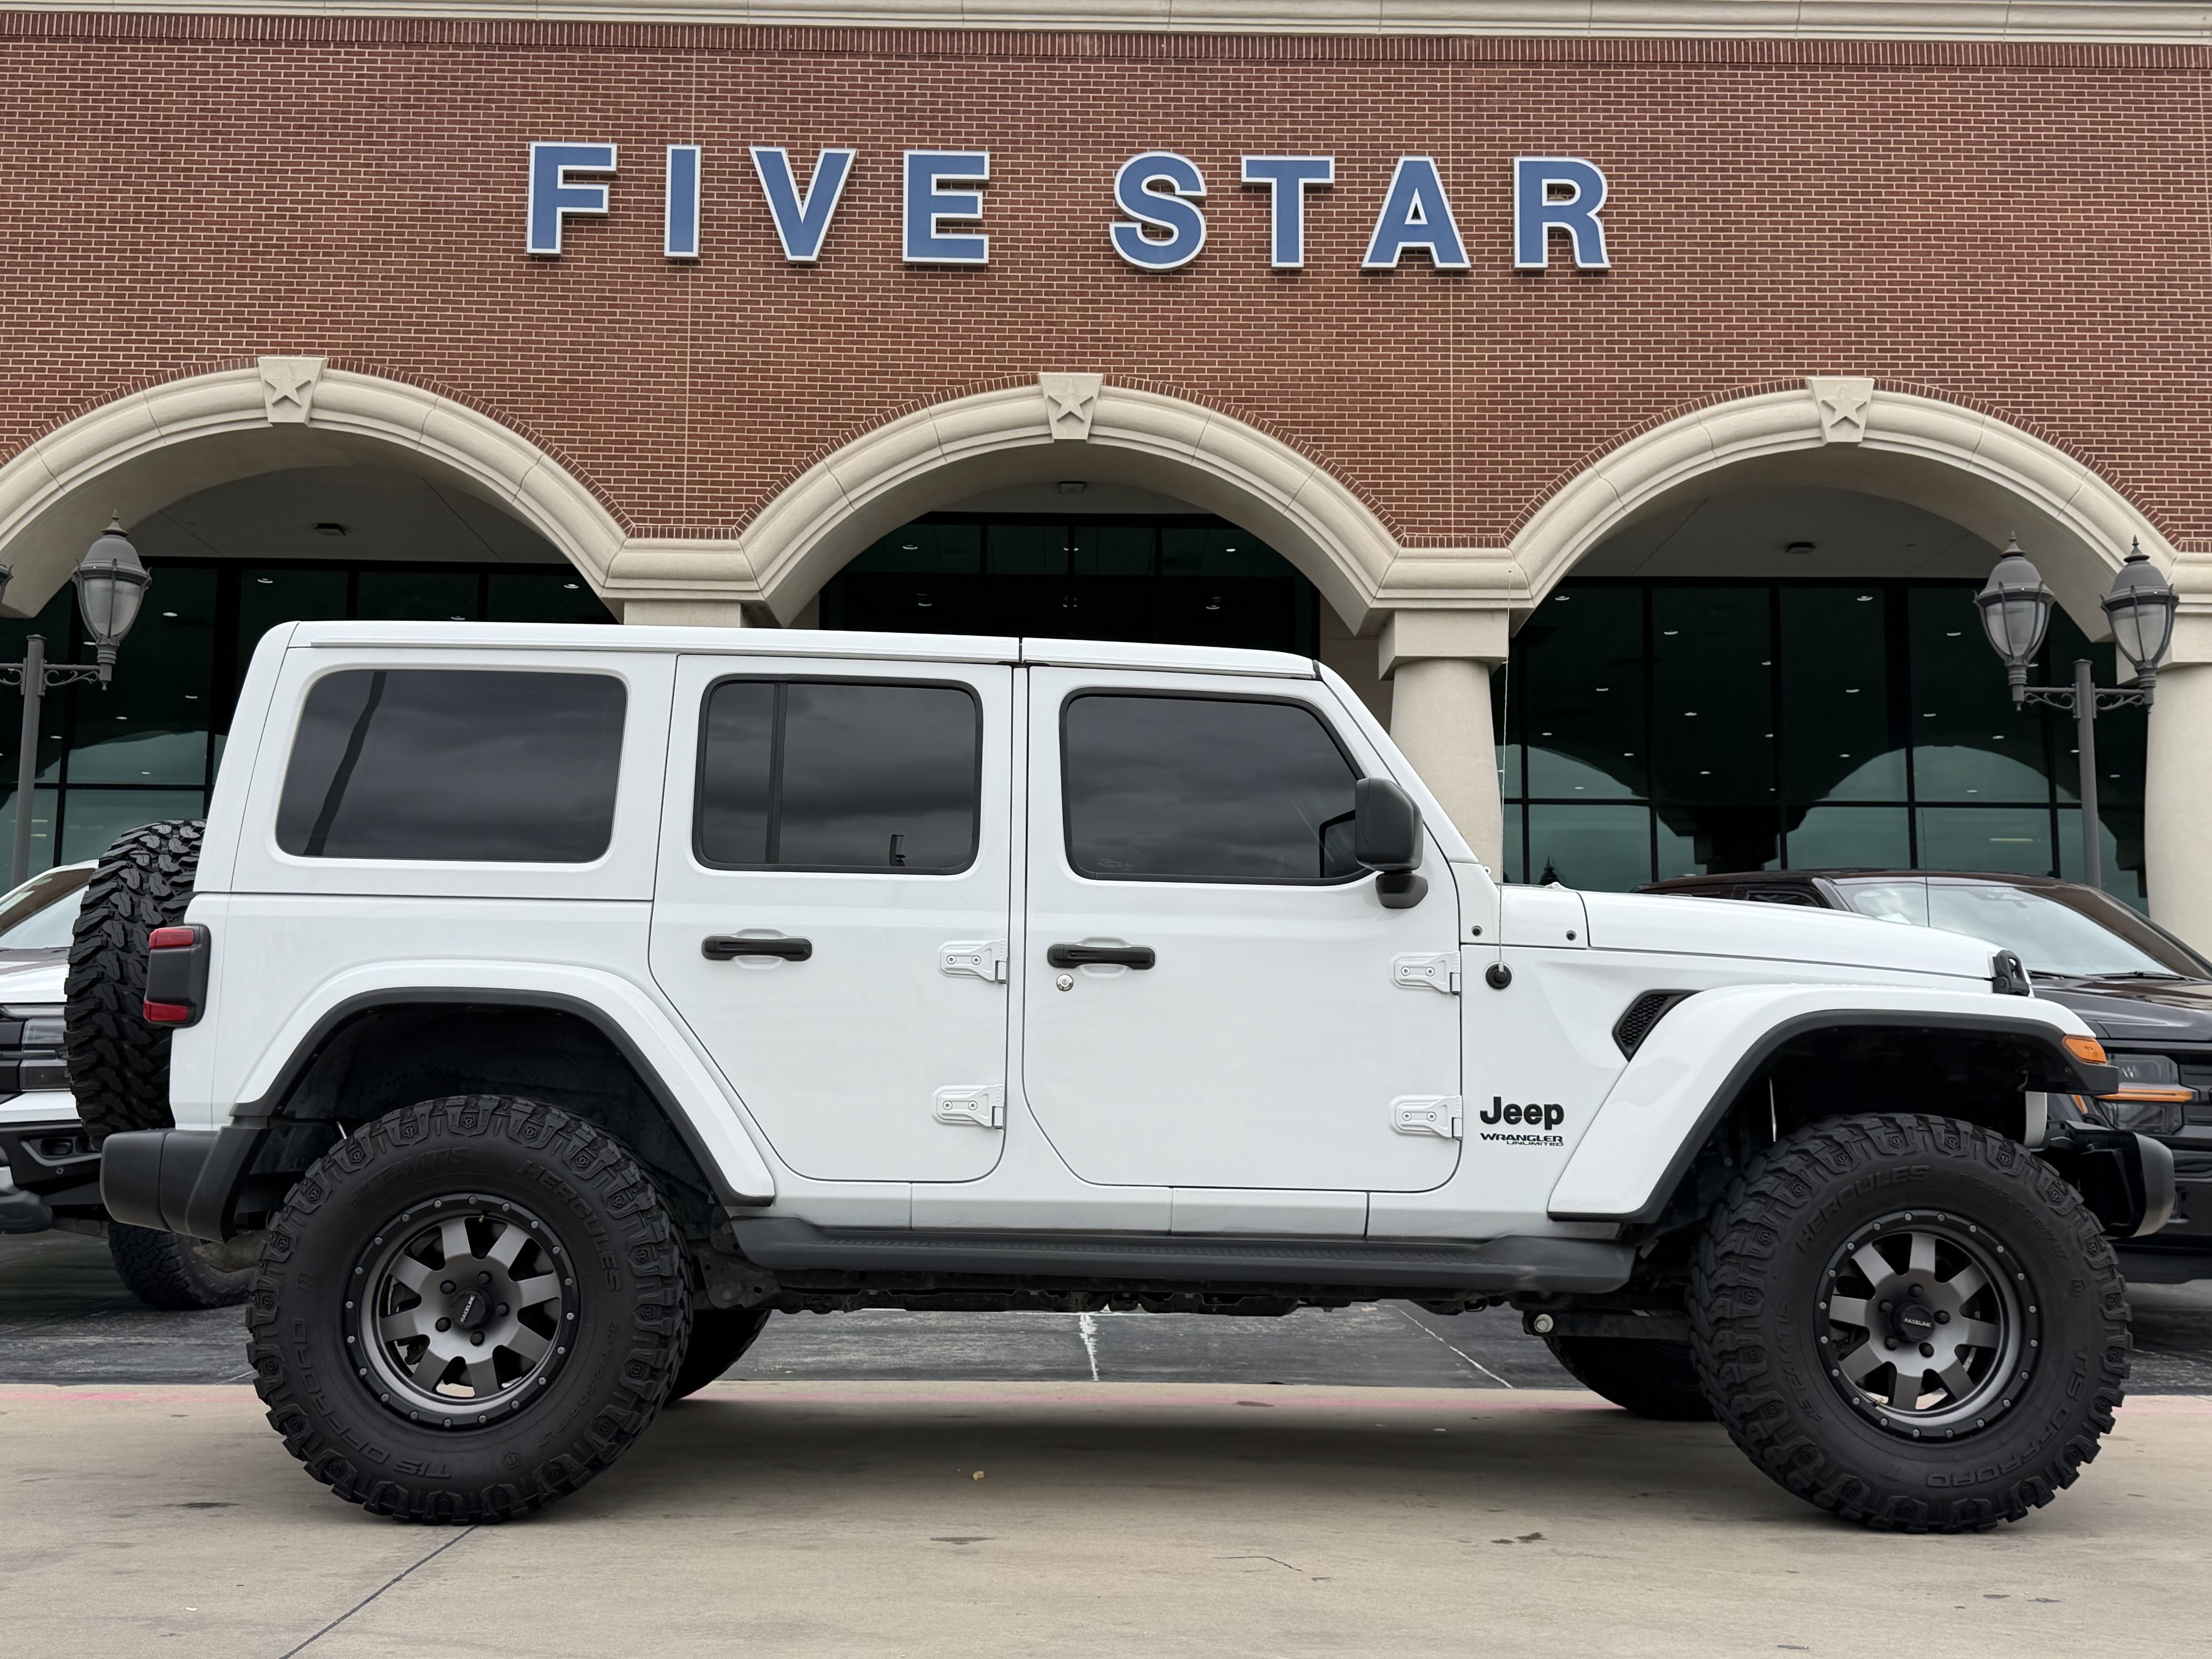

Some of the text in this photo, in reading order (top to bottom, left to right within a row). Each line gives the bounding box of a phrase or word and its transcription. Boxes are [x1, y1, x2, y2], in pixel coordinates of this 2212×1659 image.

[527, 141, 1612, 271] FIVE STAR
[1480, 1096, 1565, 1130] Jeep
[1480, 1133, 1564, 1142] WRANGLER
[517, 1160, 621, 1291] HERCULES
[1796, 1165, 1931, 1253] HERCULES
[460, 1295, 475, 1322] RACELINE
[292, 1318, 452, 1479] TIS OFFROAD
[1926, 1345, 2091, 1488] TIS OFFROAD
